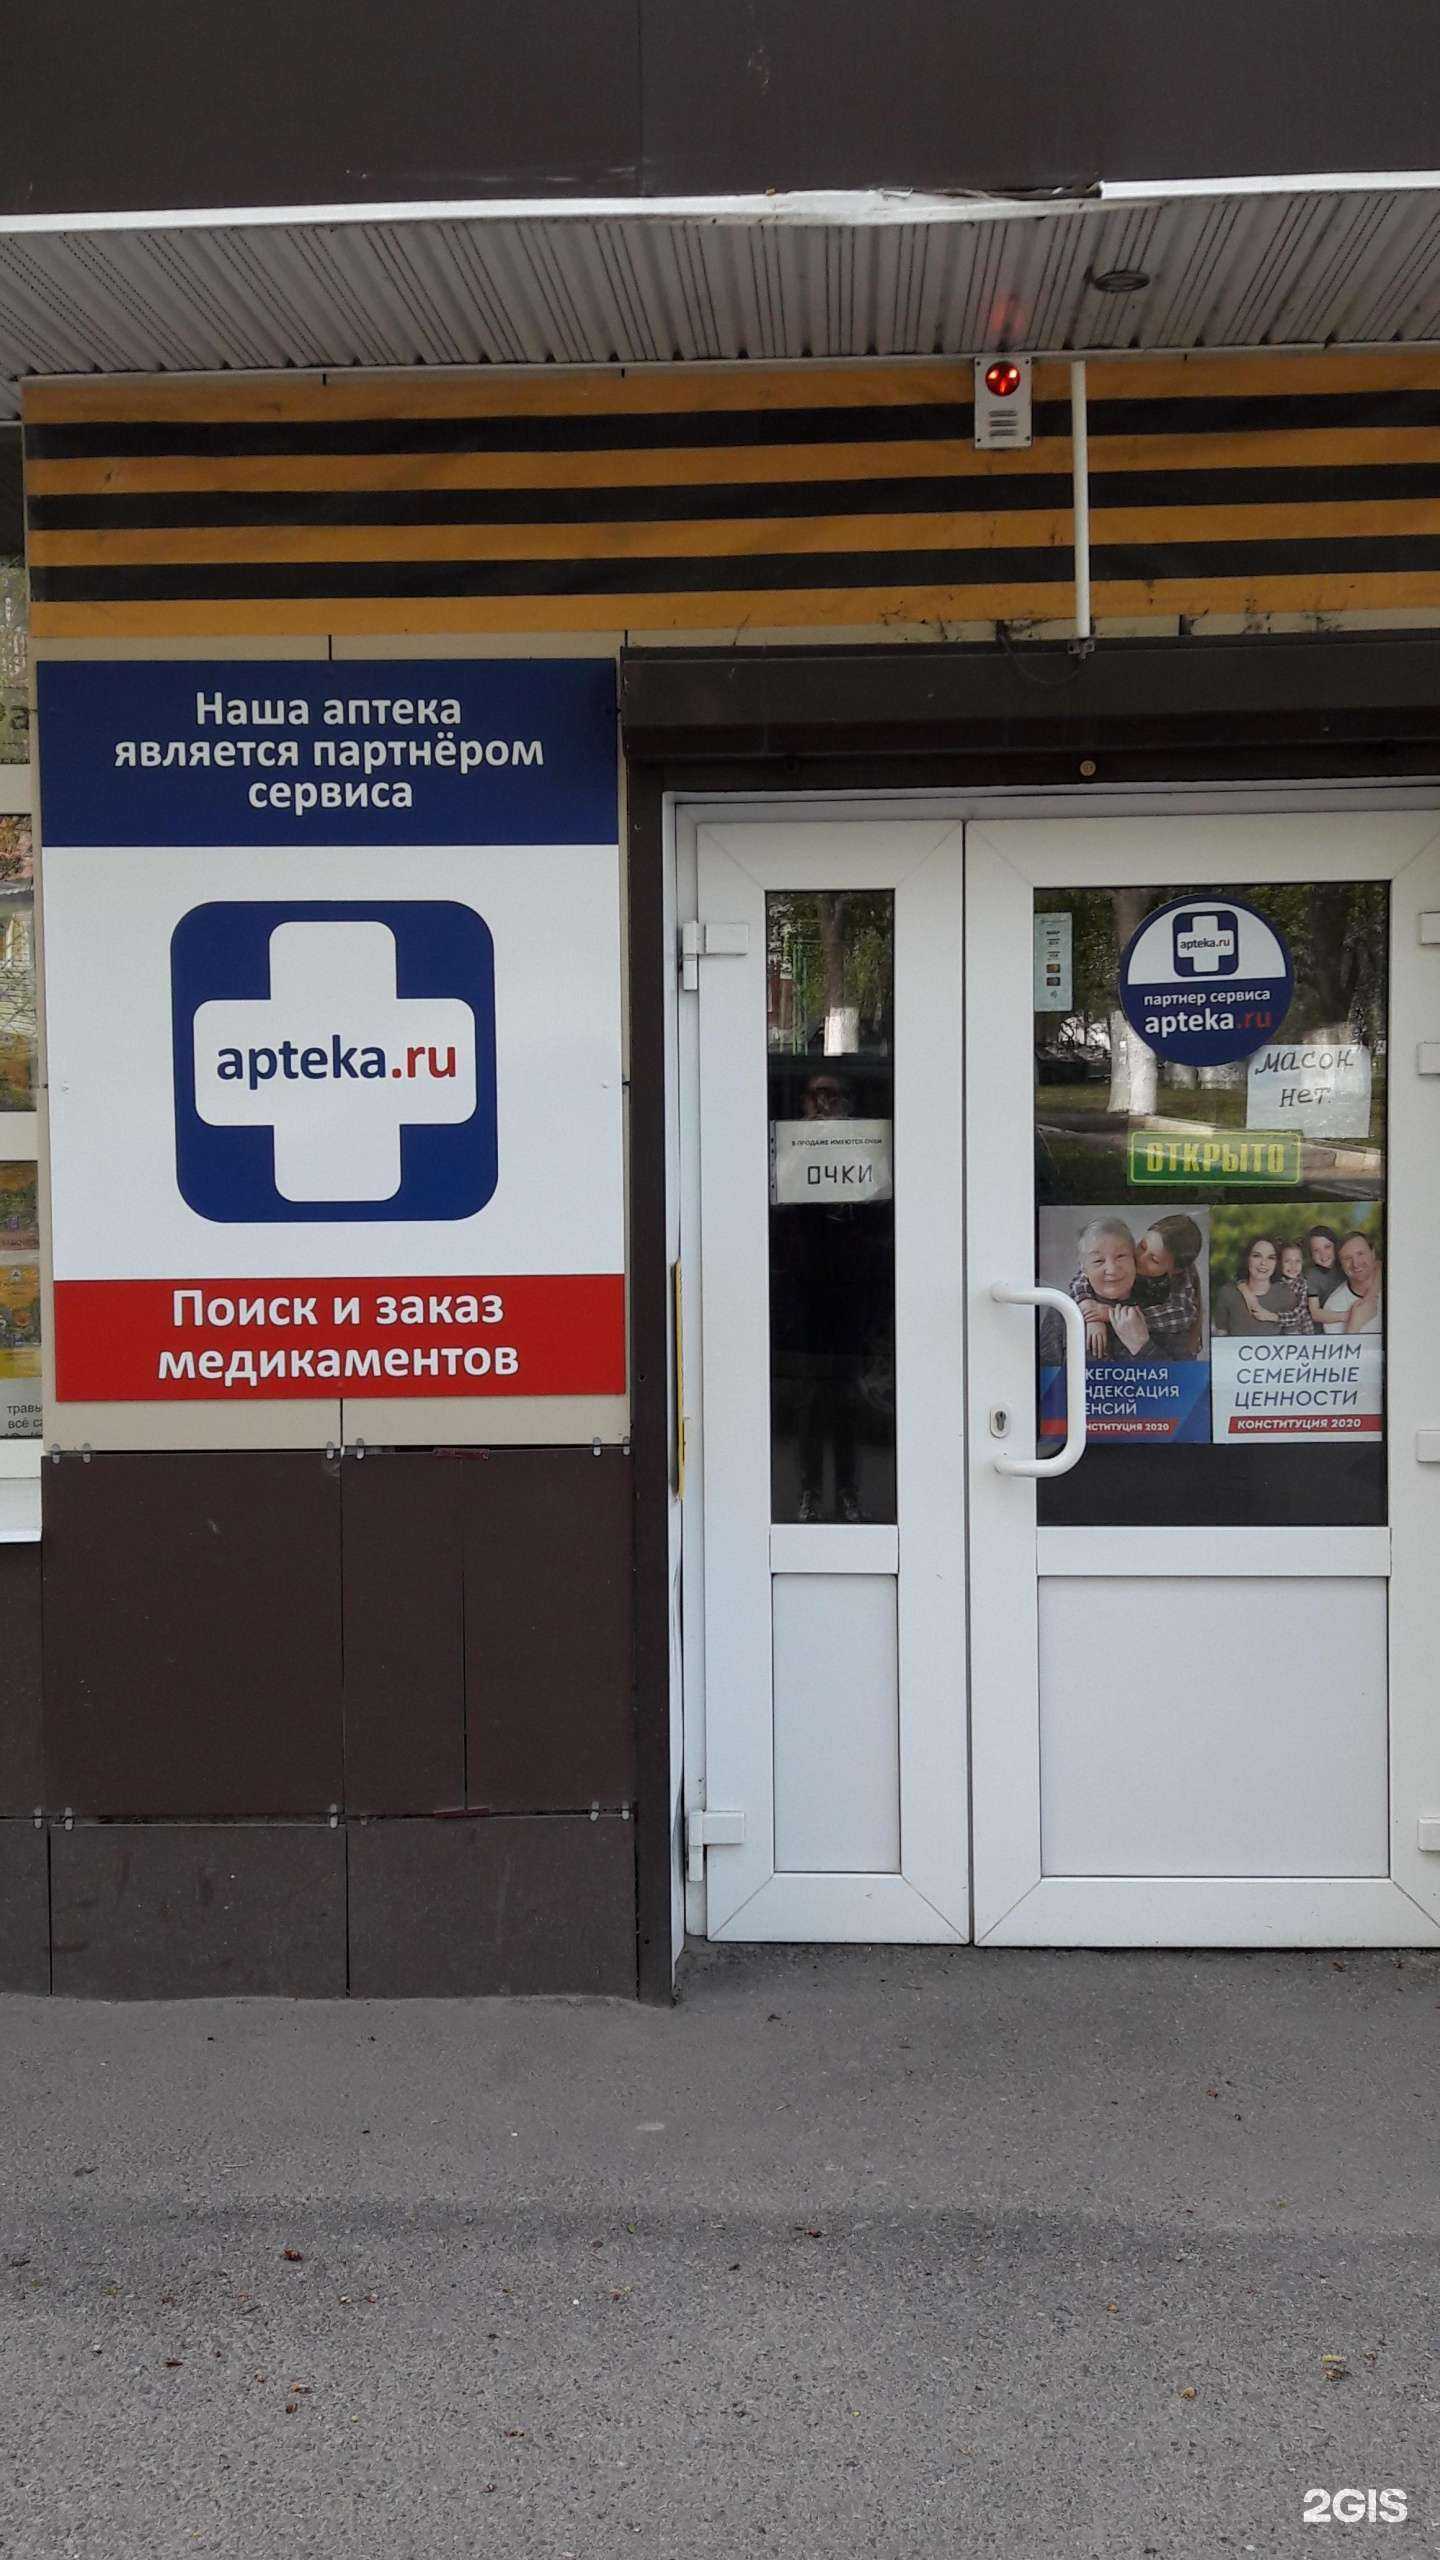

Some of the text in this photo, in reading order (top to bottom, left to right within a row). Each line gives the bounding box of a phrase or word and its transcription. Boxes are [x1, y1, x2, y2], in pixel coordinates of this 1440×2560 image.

[196, 691, 462, 726] Наша аптека
[114, 732, 544, 775] является партнёром
[248, 781, 414, 816] сервиса
[1179, 937, 1231, 950] apteka.ru
[1144, 989, 1271, 1008] партнер сервиса
[1144, 1008, 1272, 1038] apteka.ru
[216, 1034, 457, 1091] apteka.ru
[1146, 1142, 1285, 1174] ОТКРЫТО
[807, 1164, 873, 1185] ОЧКИ
[173, 1289, 504, 1327] Поиск и заказ
[1238, 1343, 1362, 1361] СОХРАНИМ
[158, 1346, 520, 1388] медикаментов
[1236, 1362, 1360, 1385] СЕМЕЙНЫЕ
[1085, 1385, 1180, 1399] НДЕКСАЦИЯ
[1234, 1390, 1359, 1410] ЦЕННОСТИ
[1085, 1399, 1138, 1416] ЕНСИЙ
[1145, 1422, 1170, 1432] 2020
[1237, 1418, 1362, 1430] КОНСТИТУЦИЯ 2020
